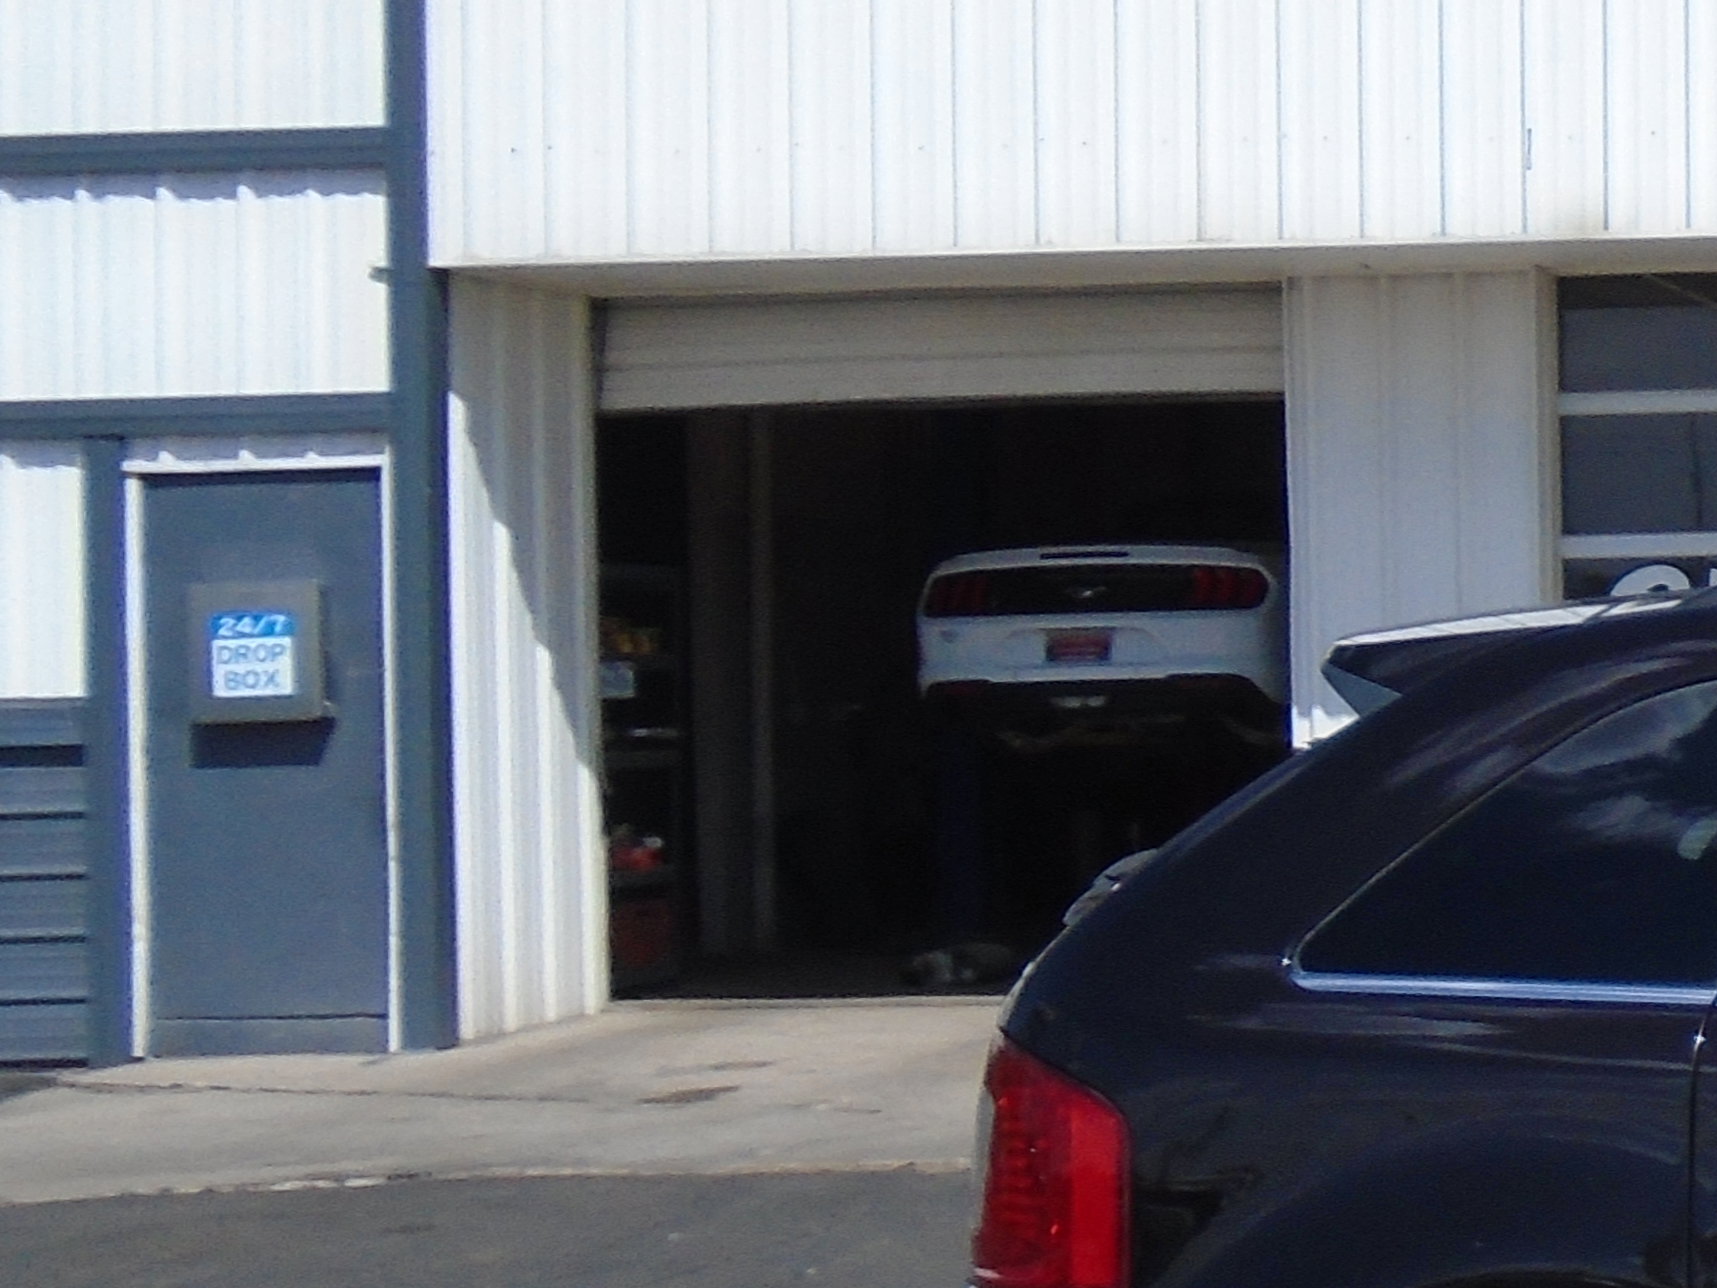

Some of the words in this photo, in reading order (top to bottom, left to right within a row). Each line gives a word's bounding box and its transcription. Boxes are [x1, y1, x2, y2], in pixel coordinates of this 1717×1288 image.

[216, 614, 287, 637] 24/7
[216, 643, 287, 665] DROP
[223, 669, 281, 691] BOX
